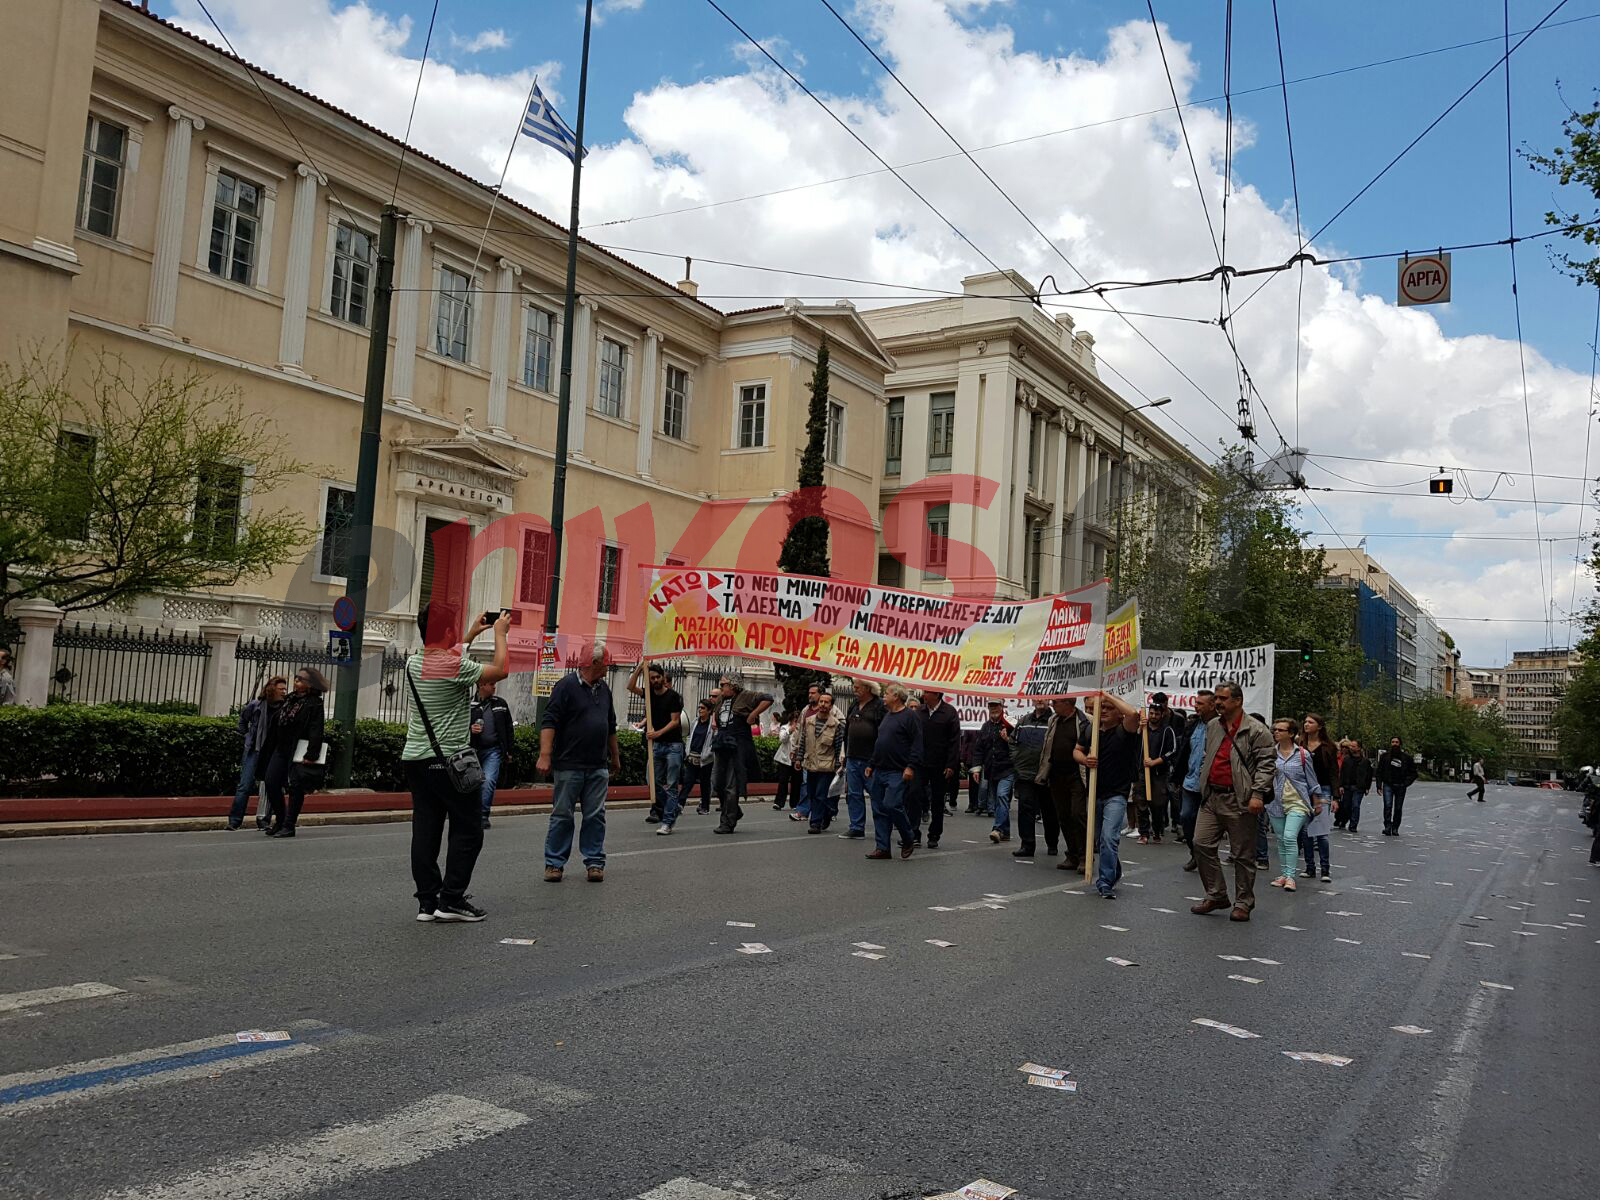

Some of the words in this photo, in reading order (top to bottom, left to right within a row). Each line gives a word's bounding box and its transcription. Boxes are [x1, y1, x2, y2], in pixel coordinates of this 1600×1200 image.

[1406, 269, 1442, 288] ΑΡΓΑ
[416, 478, 503, 505] ΑΡΣΑΚΕΙΟΝ
[648, 571, 702, 614] ΚΑΤΩ
[723, 573, 745, 590] ΤΟ
[752, 575, 779, 592] ΝΕΟ
[786, 578, 872, 607] ΜΝΗΜΟΝΙΟ
[674, 616, 739, 633] ΜΑΖΙΚΟΙ
[722, 592, 744, 613] ΤΑ
[746, 595, 802, 620] ΔΕΣΜΑ
[812, 602, 842, 626] ΤΟΥ
[849, 609, 966, 646] ΙΜΠΕΡΙΑΛΙΣΜΟΥ
[744, 622, 825, 661] ΑΓΩΝΕΣ
[837, 635, 860, 655] ΓΙΑ
[1040, 623, 1091, 647] ΑΝΤΙΣΤΑΣΗ
[835, 652, 862, 668] ΤΗΝ
[862, 641, 961, 683] ΑΝΑΤΡΟΠΗ
[982, 655, 1004, 670] ΤΗΣ
[1031, 650, 1072, 667] ΑΡΙΣΤΕΡΗ
[1190, 648, 1266, 670] ΑΣΦΑΛΙΣΗ
[962, 669, 1017, 688] ΕΠΙΘΕΣΗΣ
[1016, 680, 1069, 697] ΣΥΝΕΡΓΑΣΙΑ
